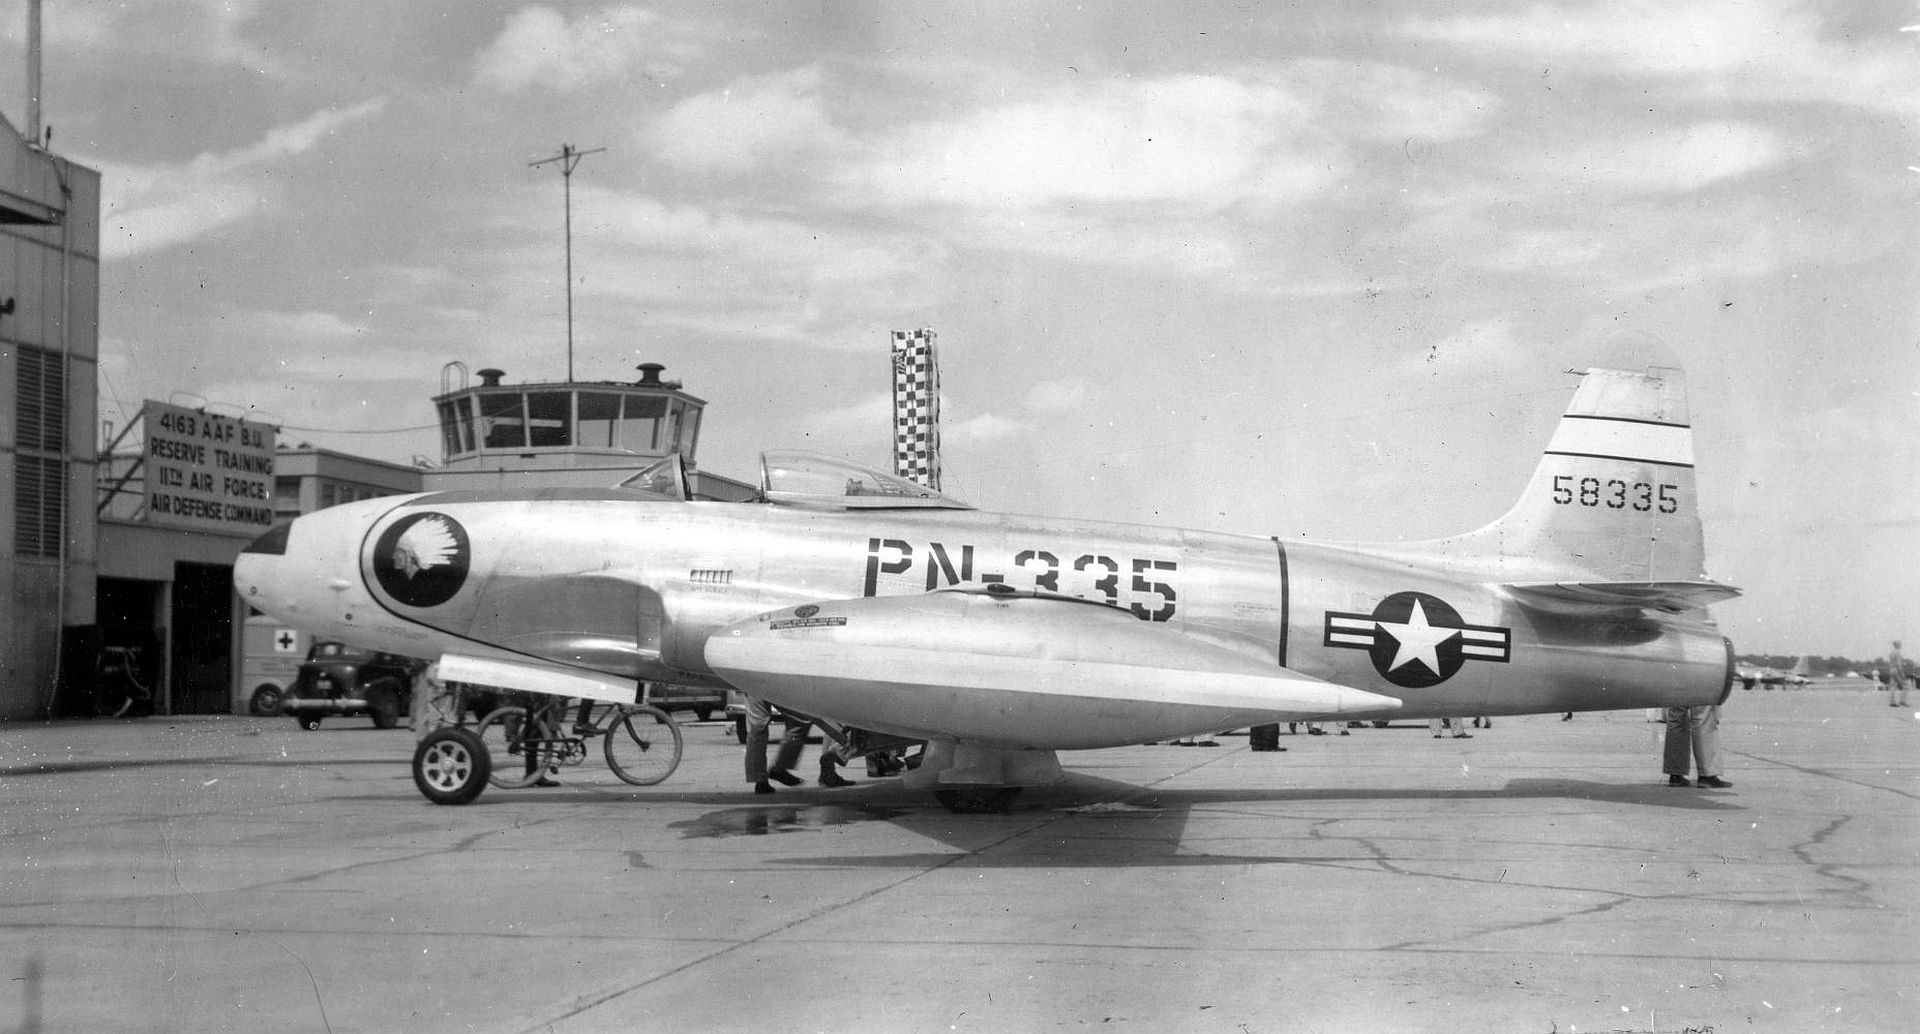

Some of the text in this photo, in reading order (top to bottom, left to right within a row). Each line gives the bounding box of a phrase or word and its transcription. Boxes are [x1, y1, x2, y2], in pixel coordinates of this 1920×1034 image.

[161, 413, 196, 436] 4163
[202, 421, 234, 442] AAF
[151, 437, 272, 477] RESERVE TRAINING
[190, 472, 214, 493] AIR
[223, 476, 264, 500] FORCE
[1553, 475, 1678, 514] 58335
[150, 493, 272, 526] AIR DEFENSE COMMAND
[864, 538, 1177, 622] PN-335
